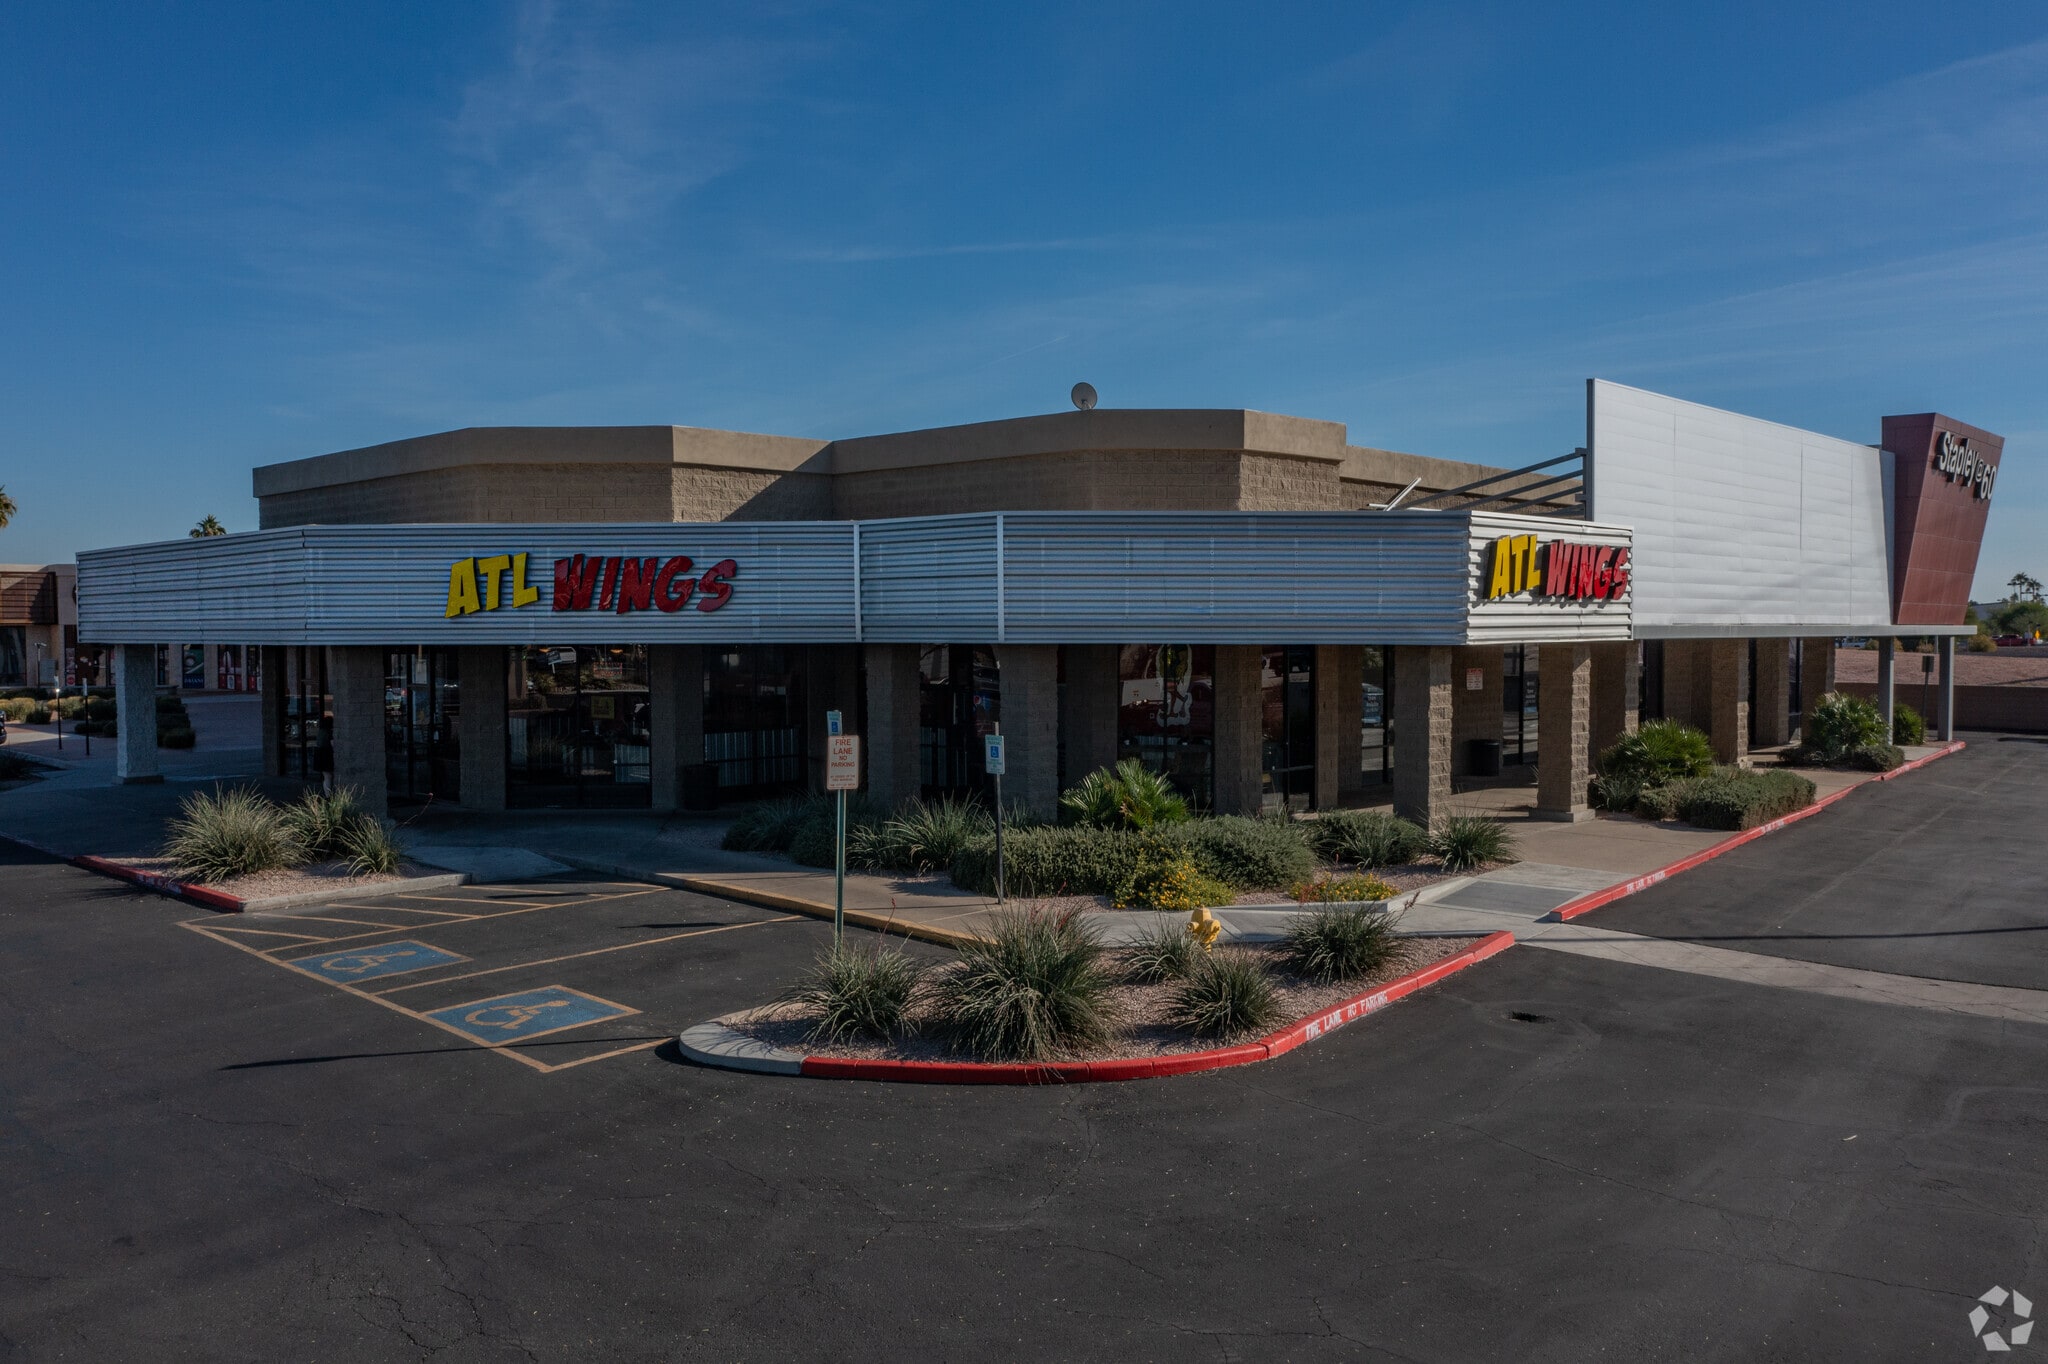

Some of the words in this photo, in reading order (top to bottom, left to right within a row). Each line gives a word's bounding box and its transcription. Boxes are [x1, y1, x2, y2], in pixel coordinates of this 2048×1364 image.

[444, 551, 539, 619] ATL
[551, 553, 738, 615] WINGS
[1487, 533, 1541, 600] ATL
[1545, 539, 1629, 601] WINGS
[833, 747, 853, 755] LANE
[835, 738, 852, 746] FIRE
